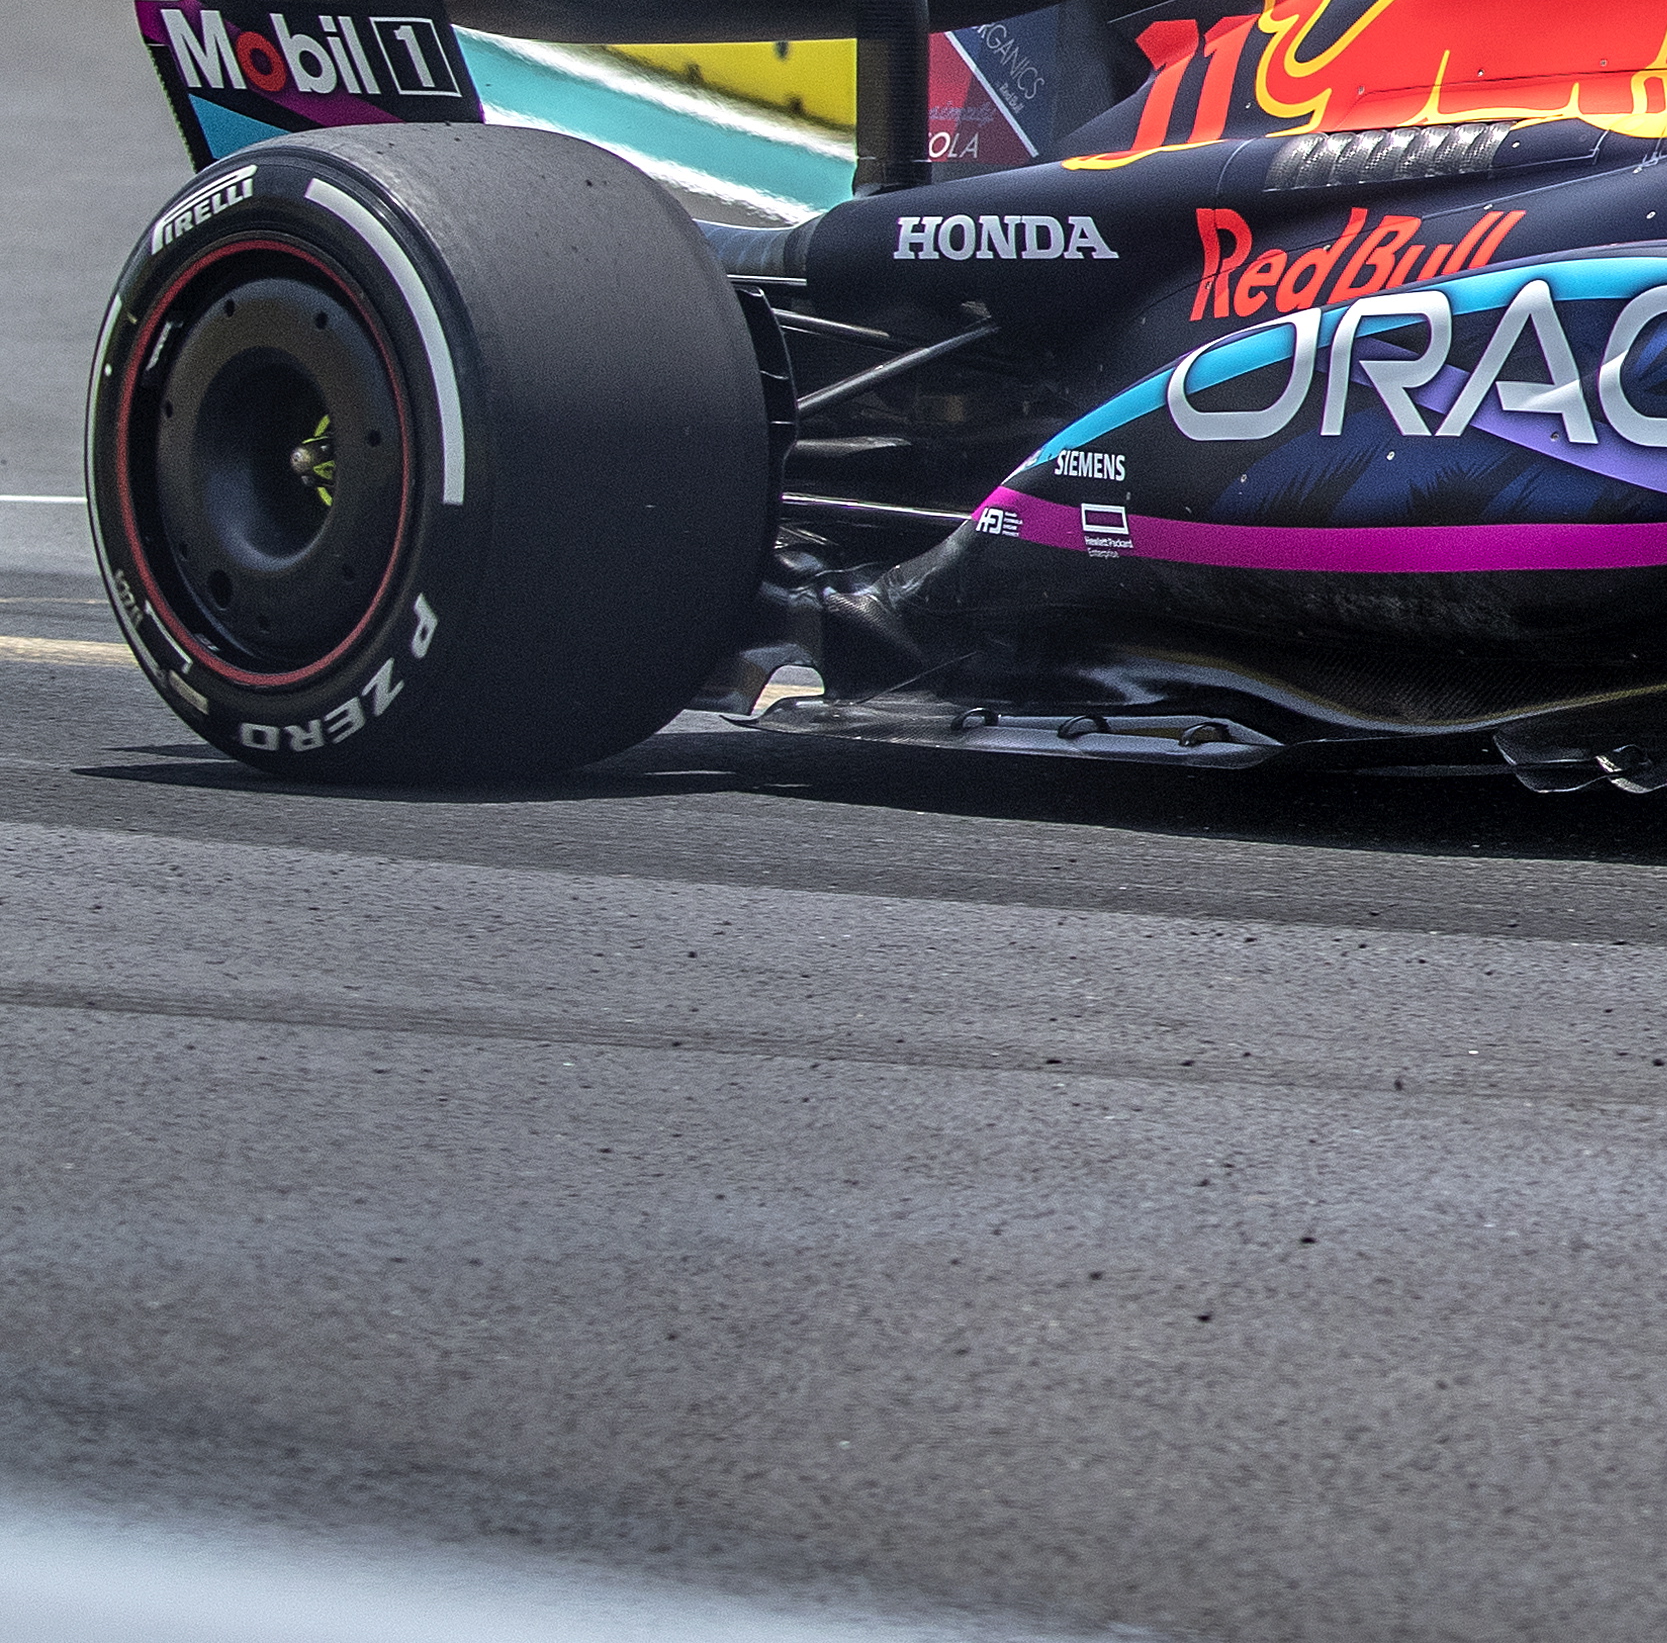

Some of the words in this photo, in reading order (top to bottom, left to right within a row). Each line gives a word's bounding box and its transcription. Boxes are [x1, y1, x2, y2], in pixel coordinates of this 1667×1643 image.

[160, 8, 381, 96] Mobil
[972, 23, 1045, 100] RGANICS
[1131, 12, 1259, 154] 11
[928, 131, 980, 159] OLA
[151, 163, 257, 255] PIRELLI
[893, 214, 1120, 261] HONDA
[1054, 449, 1127, 482] SIEMENS
[239, 657, 405, 753] ZERO
